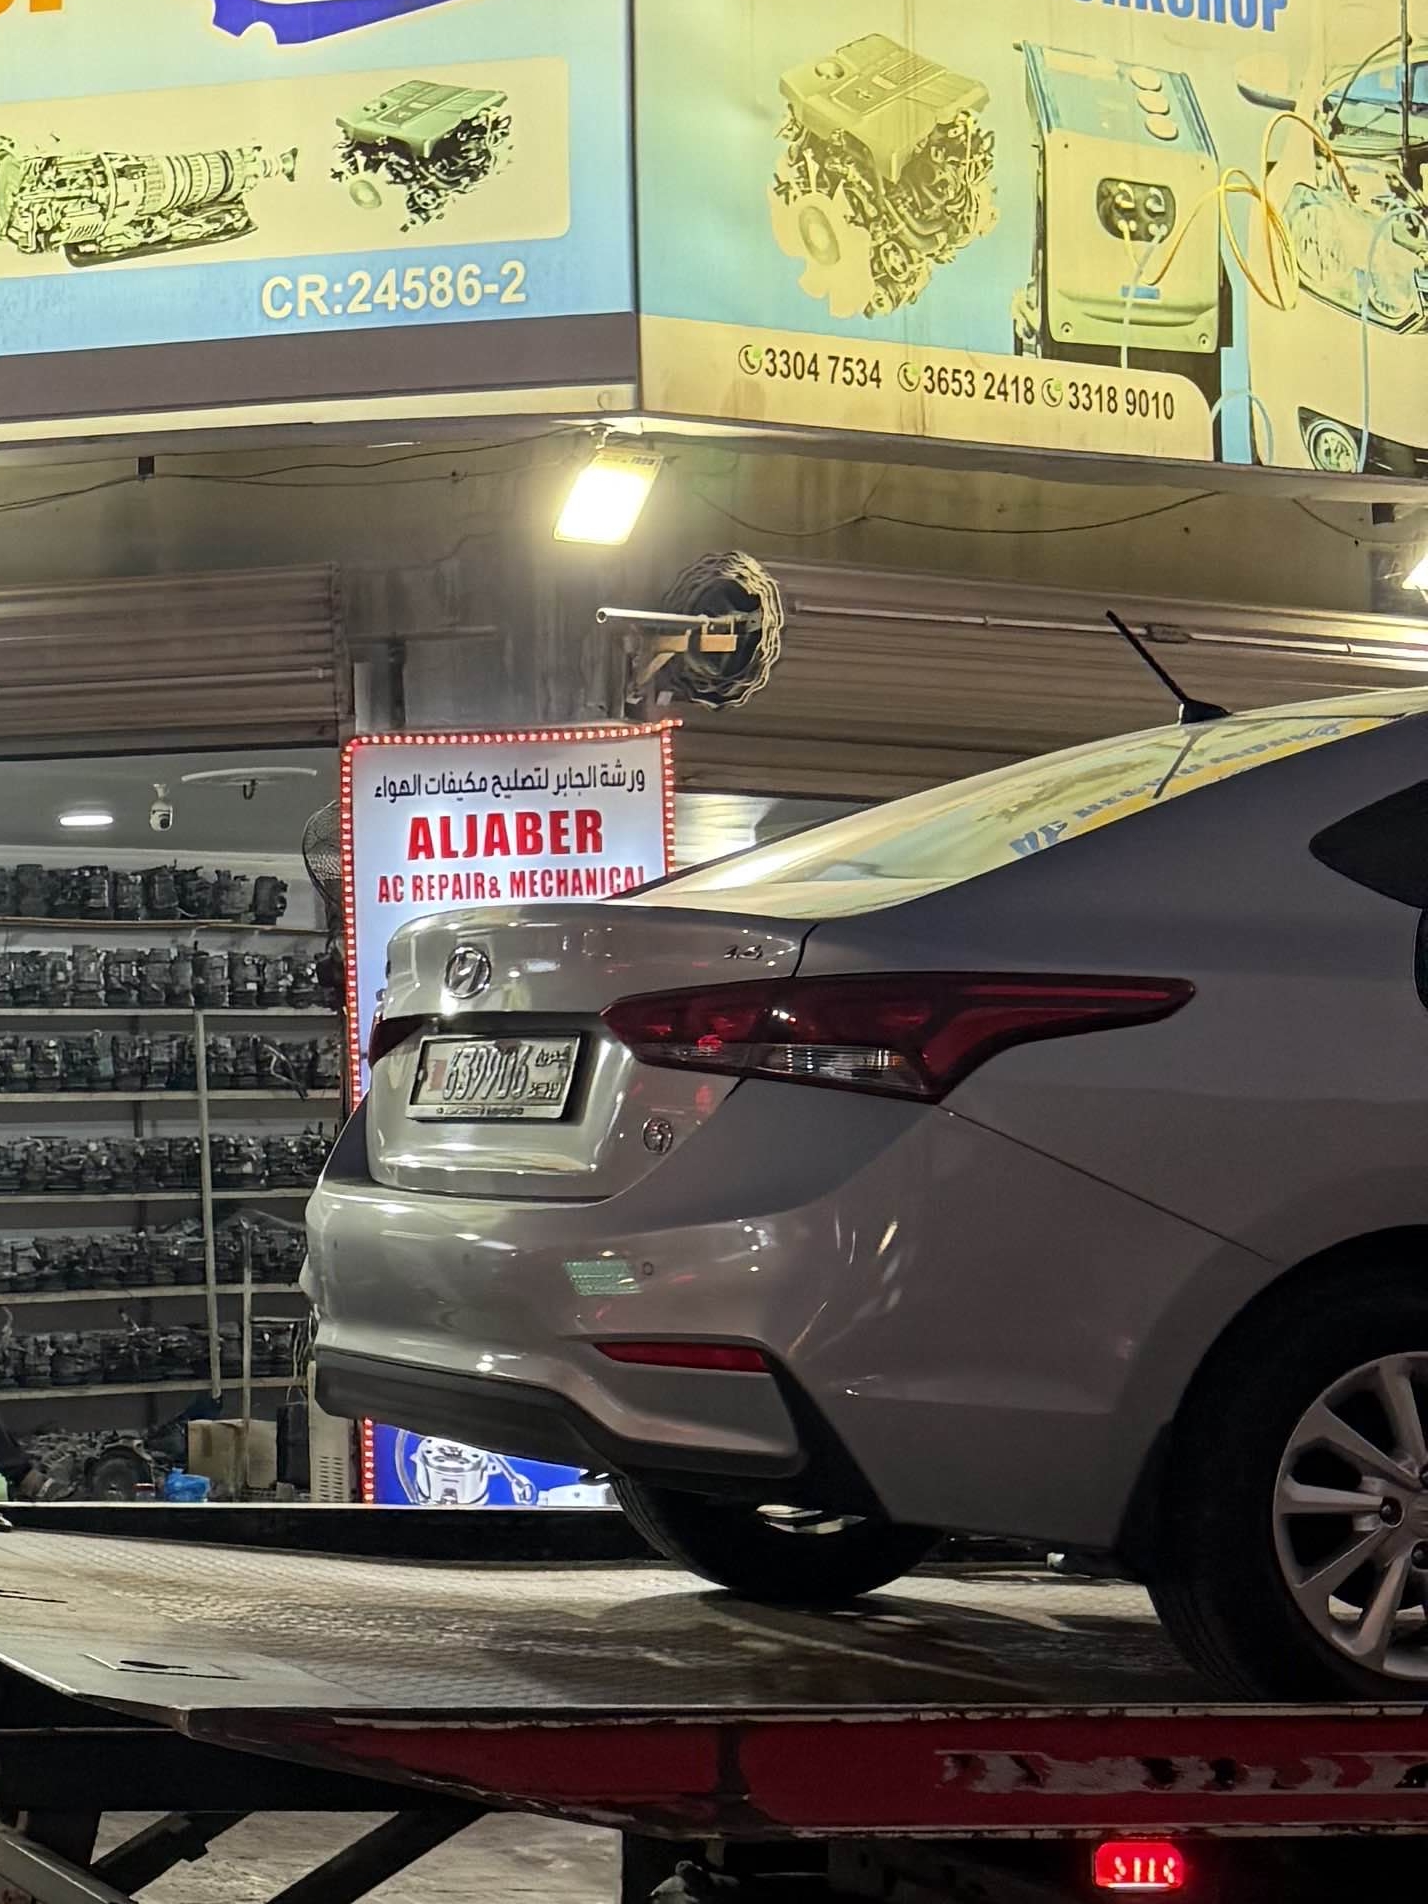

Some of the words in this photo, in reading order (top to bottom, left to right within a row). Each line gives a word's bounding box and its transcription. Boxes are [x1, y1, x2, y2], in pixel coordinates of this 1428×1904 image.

[261, 261, 527, 321] CR:24586-2
[764, 347, 820, 382] 3304
[828, 355, 882, 389] 7534
[923, 365, 976, 398] 3653
[984, 371, 1035, 406] 2418
[1068, 381, 1118, 415] 3318
[1126, 387, 1174, 420] 9010
[374, 773, 421, 803] الهواء
[425, 770, 488, 802] مكيفات
[492, 767, 548, 799] لتصليح
[552, 765, 597, 797] الجابر
[600, 758, 645, 794] ورشة
[407, 808, 603, 861] ALJABER
[378, 875, 405, 903] AC
